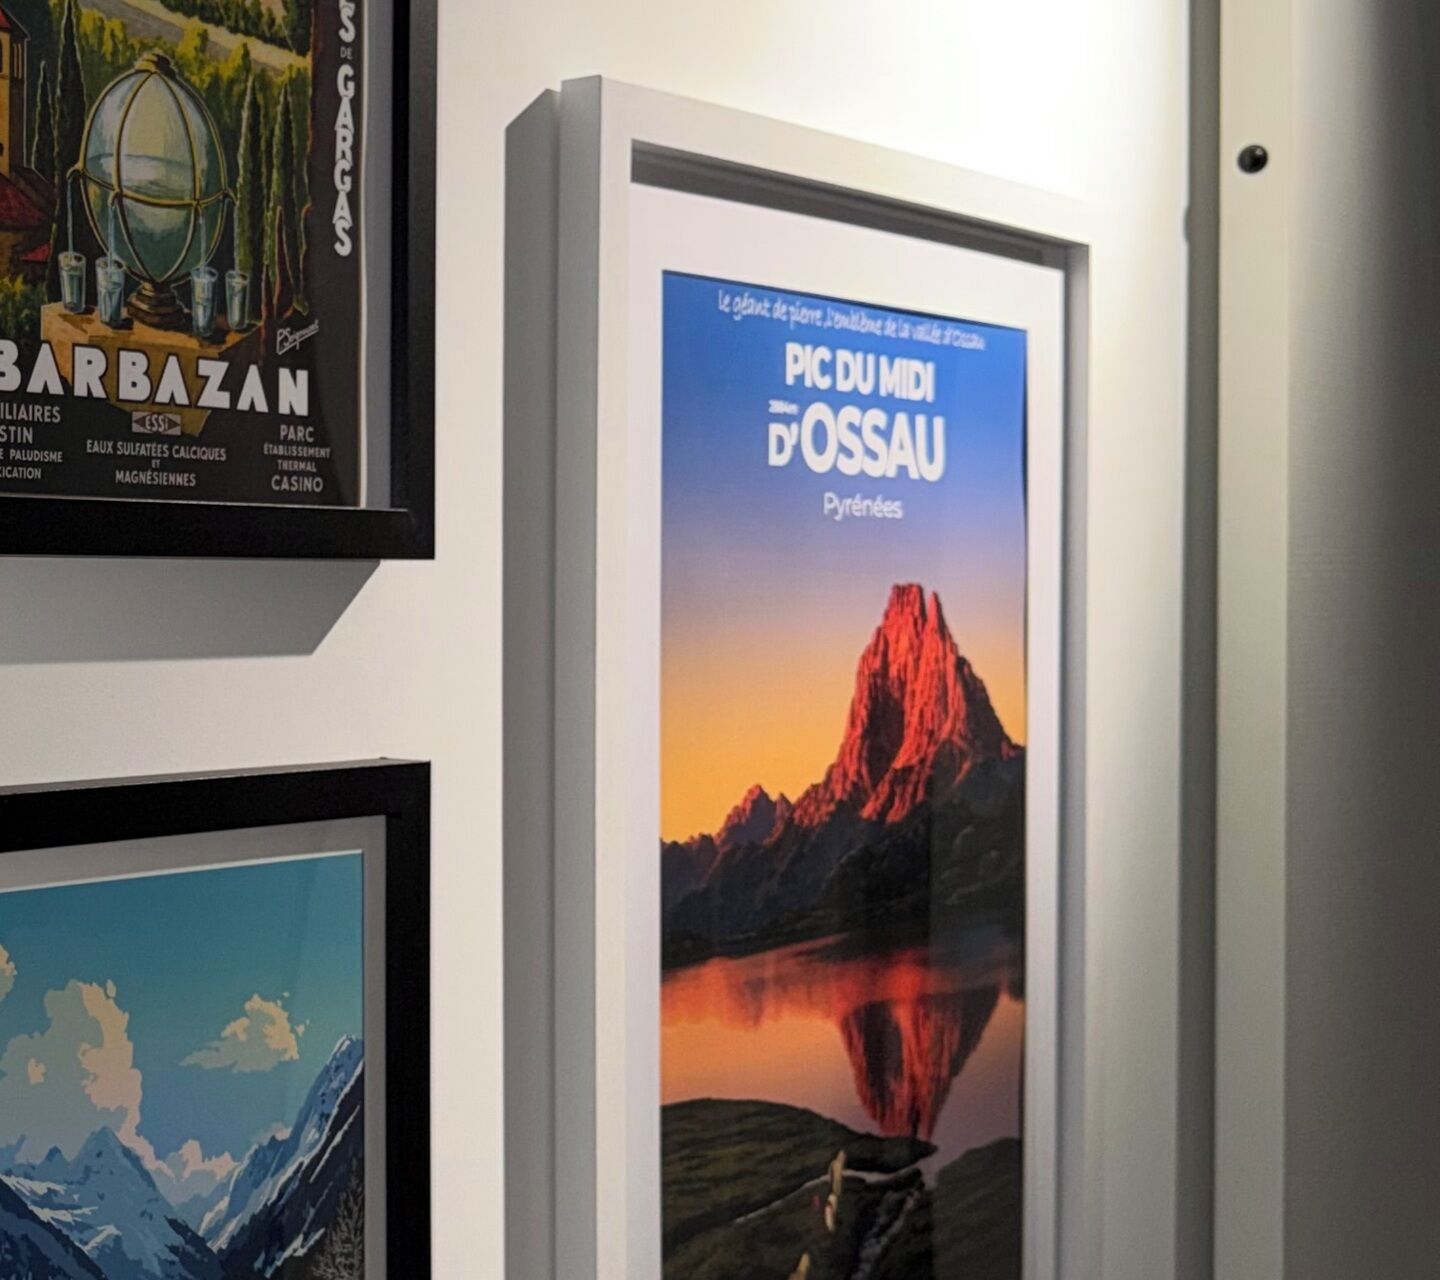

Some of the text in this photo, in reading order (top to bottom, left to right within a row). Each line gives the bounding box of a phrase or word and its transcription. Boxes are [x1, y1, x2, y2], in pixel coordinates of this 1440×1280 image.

[339, 46, 353, 60] DE
[333, 64, 356, 256] GARGAS
[772, 298, 788, 321] de
[785, 342, 935, 402] PIC DU MIDI
[280, 424, 315, 443] PARC
[768, 402, 945, 482] D'OSSAU
[10, 449, 63, 463] PALUDISME
[86, 439, 227, 462] EAUX SULFATÉES CALCIQUES
[264, 441, 331, 459] ÉTABLISSEMENT
[277, 459, 316, 472] THERMAL
[115, 469, 196, 487] MAGNÉSIENNES
[271, 475, 323, 492] CASINO
[824, 492, 903, 521] Pyrénées
